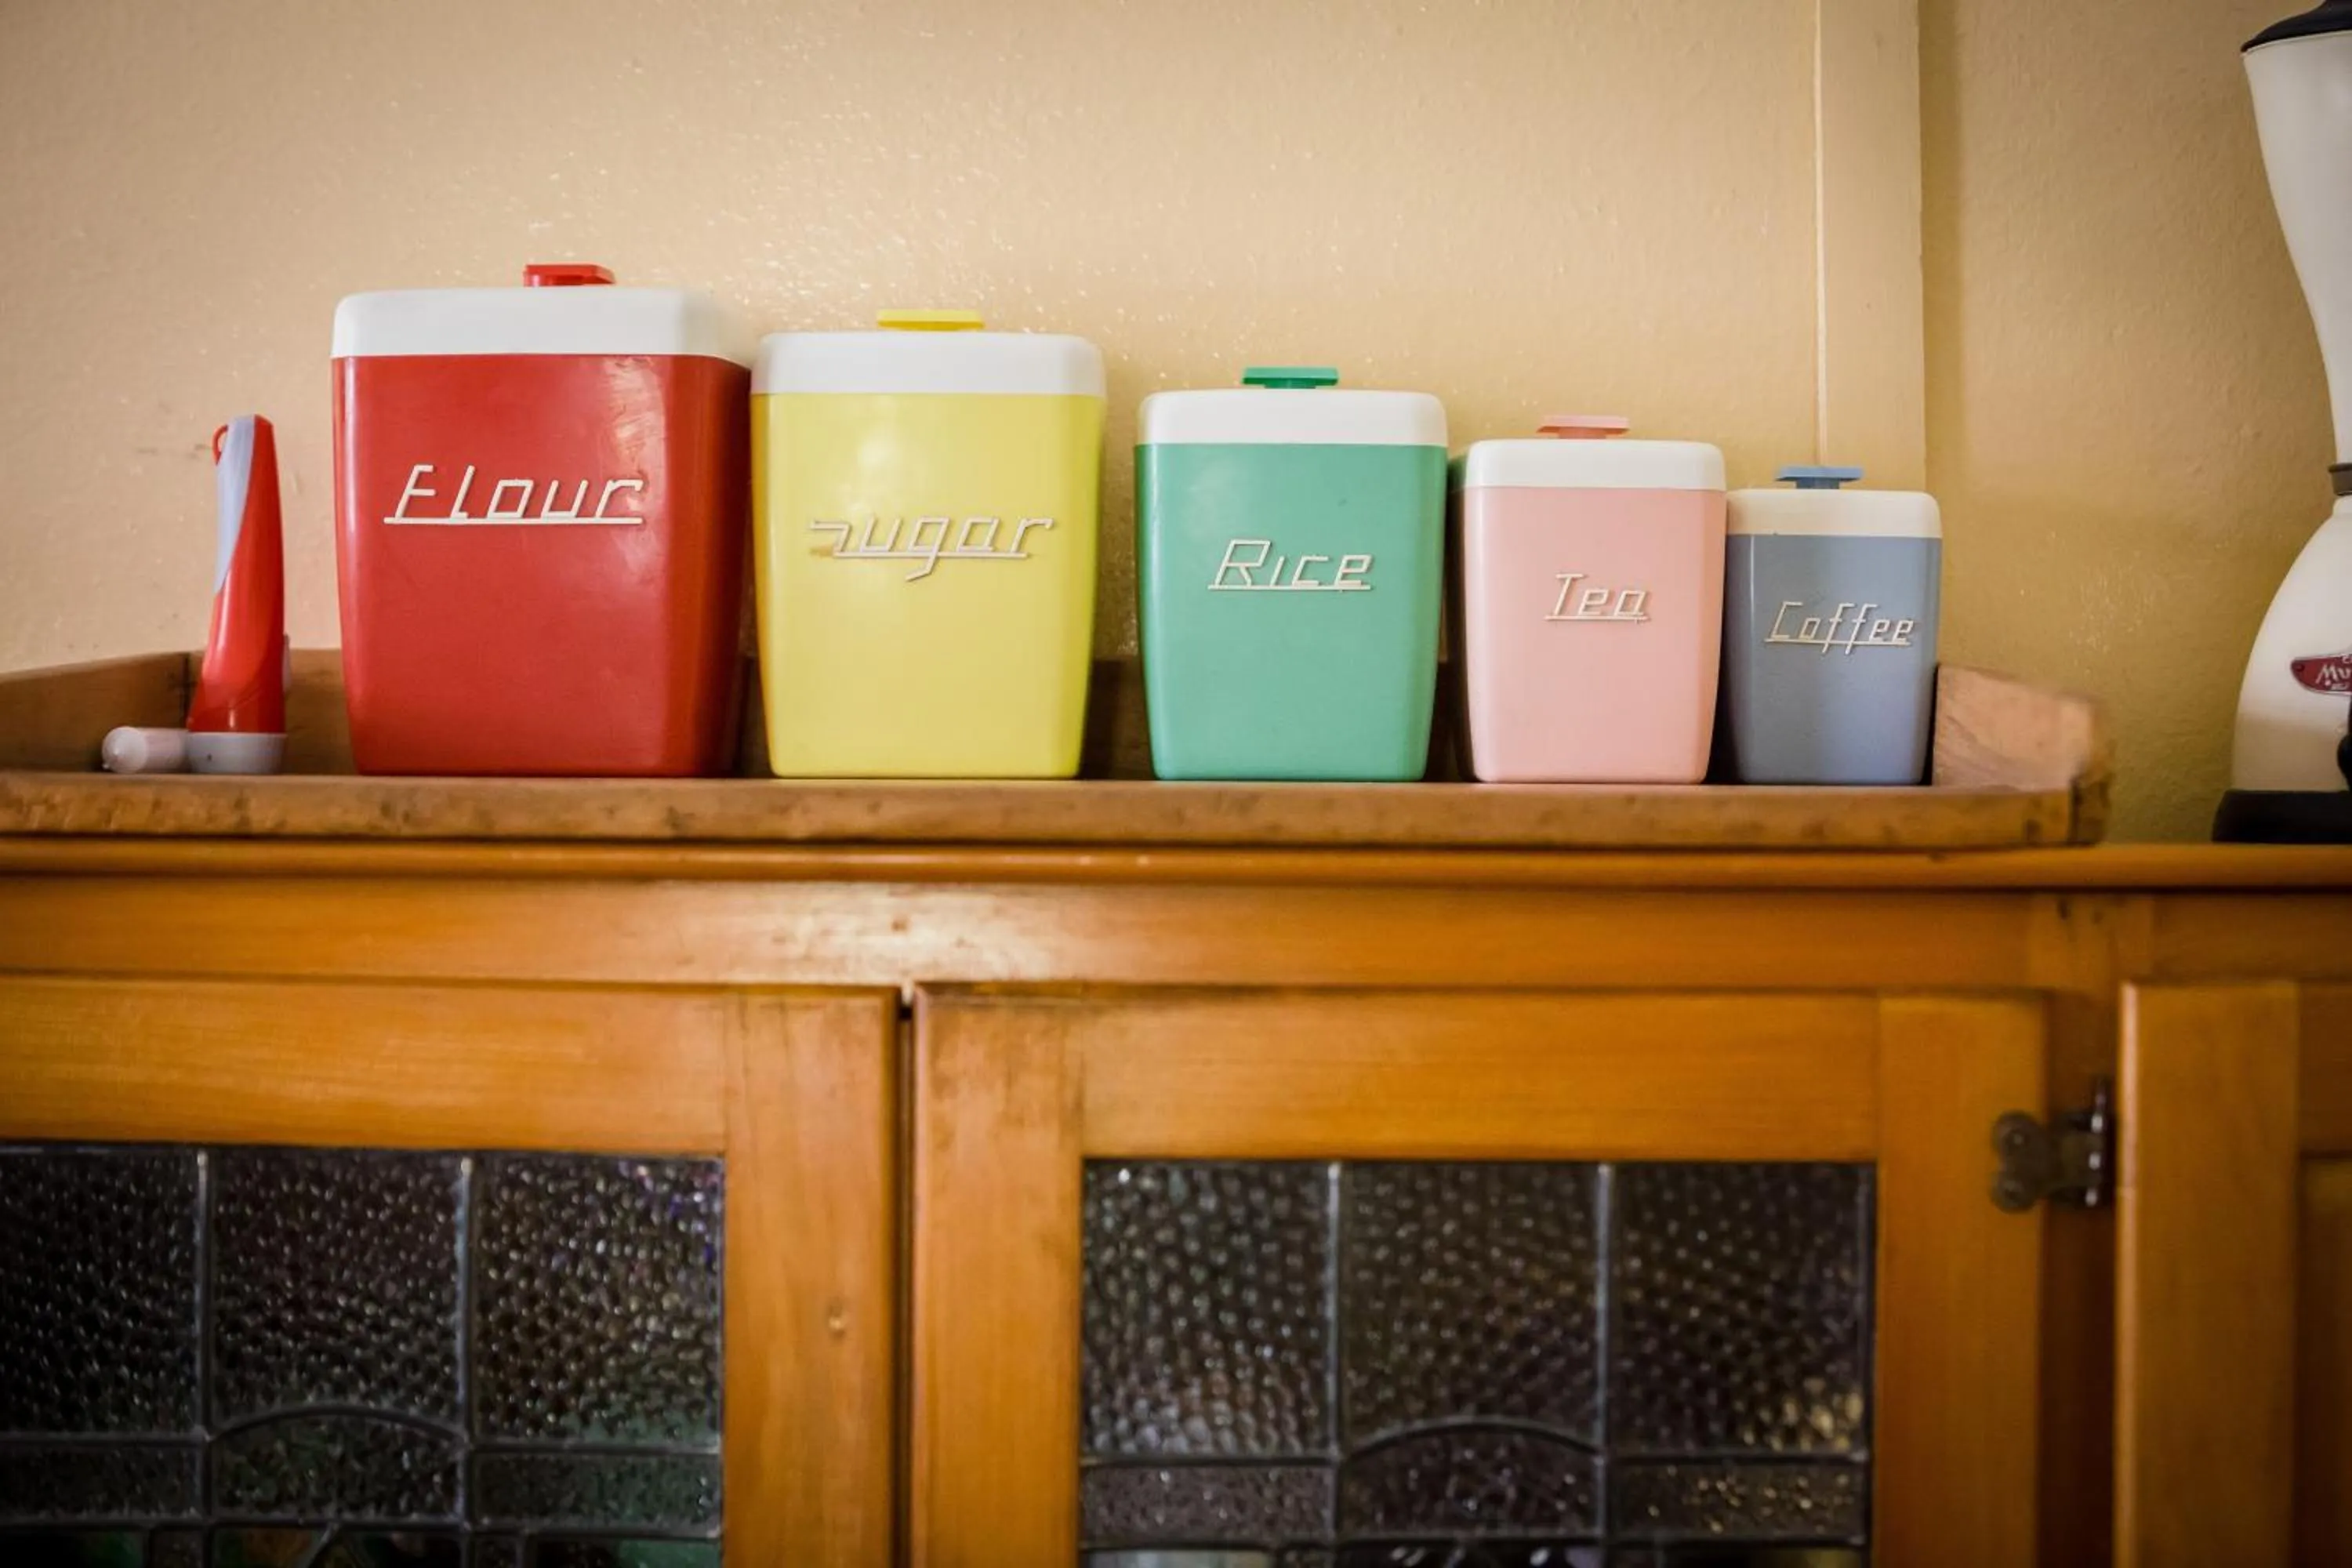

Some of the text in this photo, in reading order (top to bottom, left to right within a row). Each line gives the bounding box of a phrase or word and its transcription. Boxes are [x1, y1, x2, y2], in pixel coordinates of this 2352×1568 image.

[384, 464, 644, 524] Flour
[1208, 539, 1372, 590] Rice
[1544, 573, 1649, 620] Tea
[1766, 601, 1915, 654] Coffee
